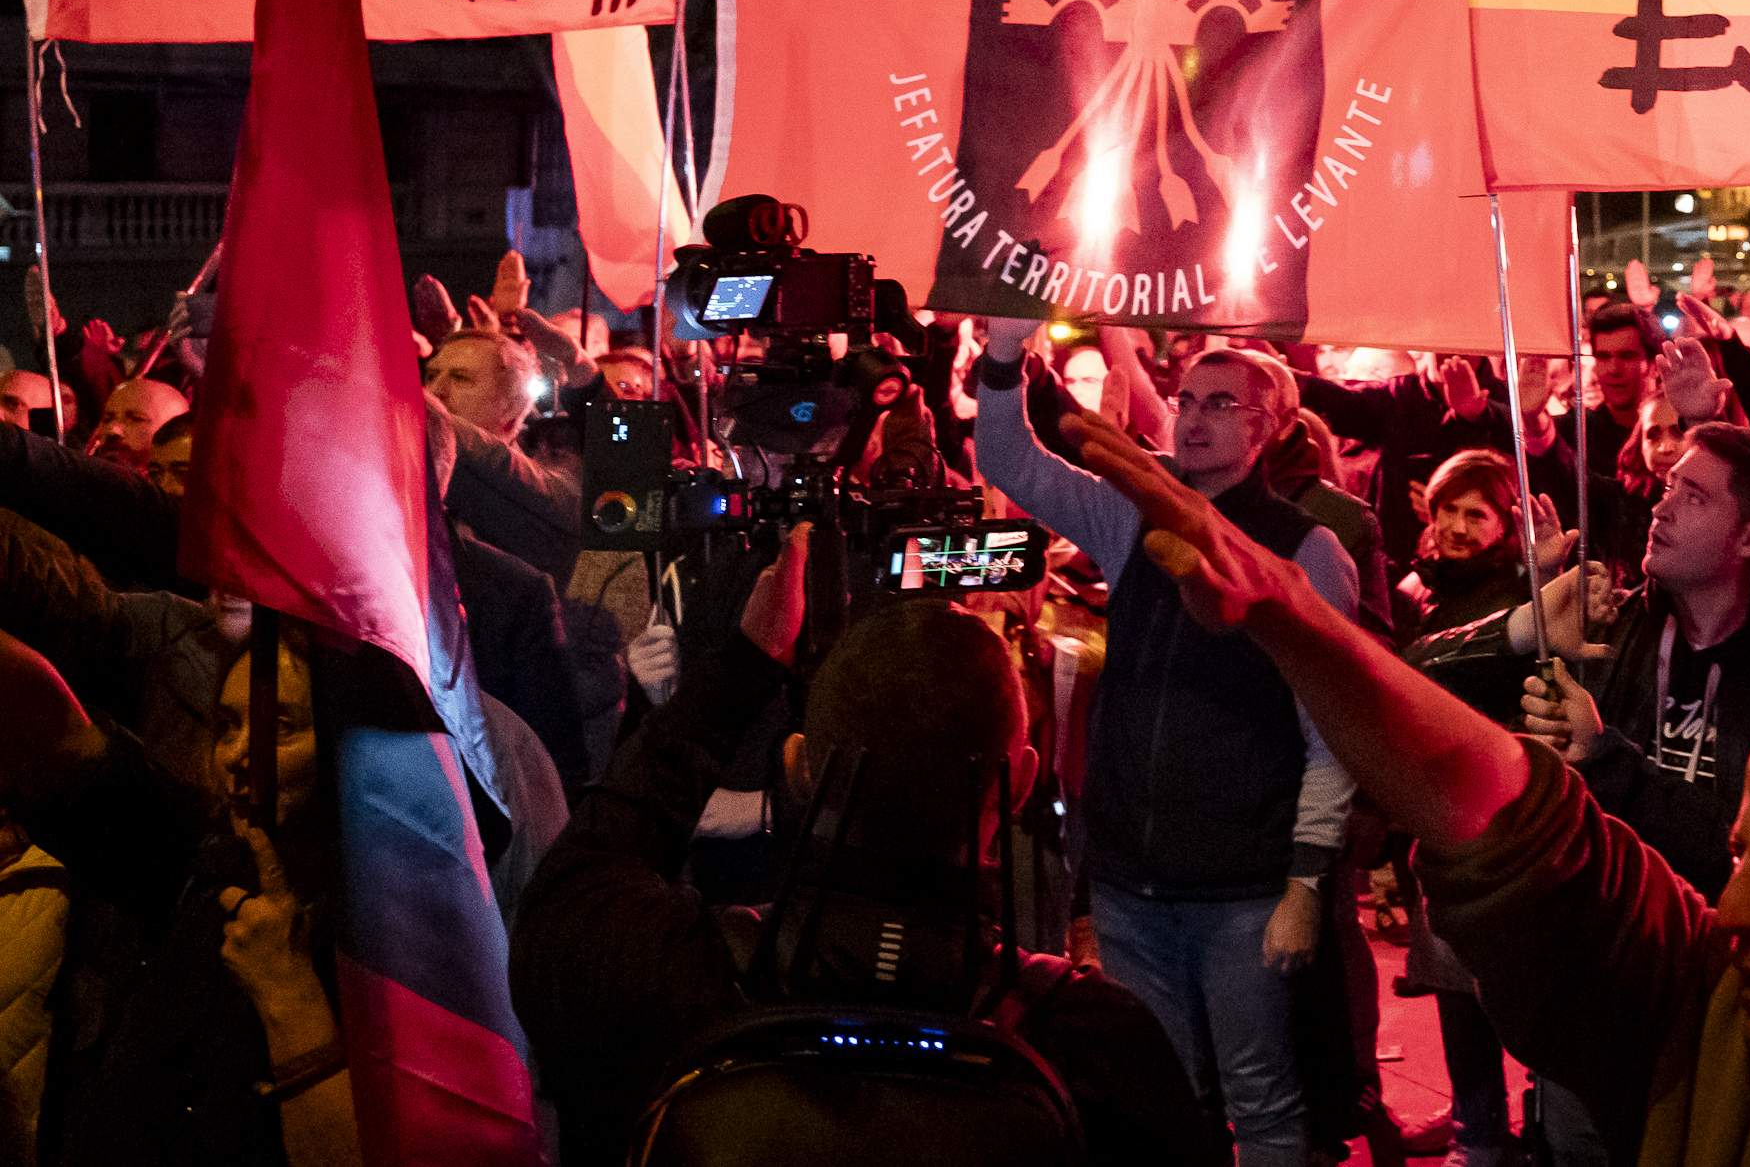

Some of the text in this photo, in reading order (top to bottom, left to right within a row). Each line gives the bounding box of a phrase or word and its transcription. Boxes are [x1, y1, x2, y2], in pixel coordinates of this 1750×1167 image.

[890, 71, 988, 249] JEFATURA
[983, 229, 1216, 317] TERRITORIAL
[1274, 77, 1393, 249] LEVANTE
